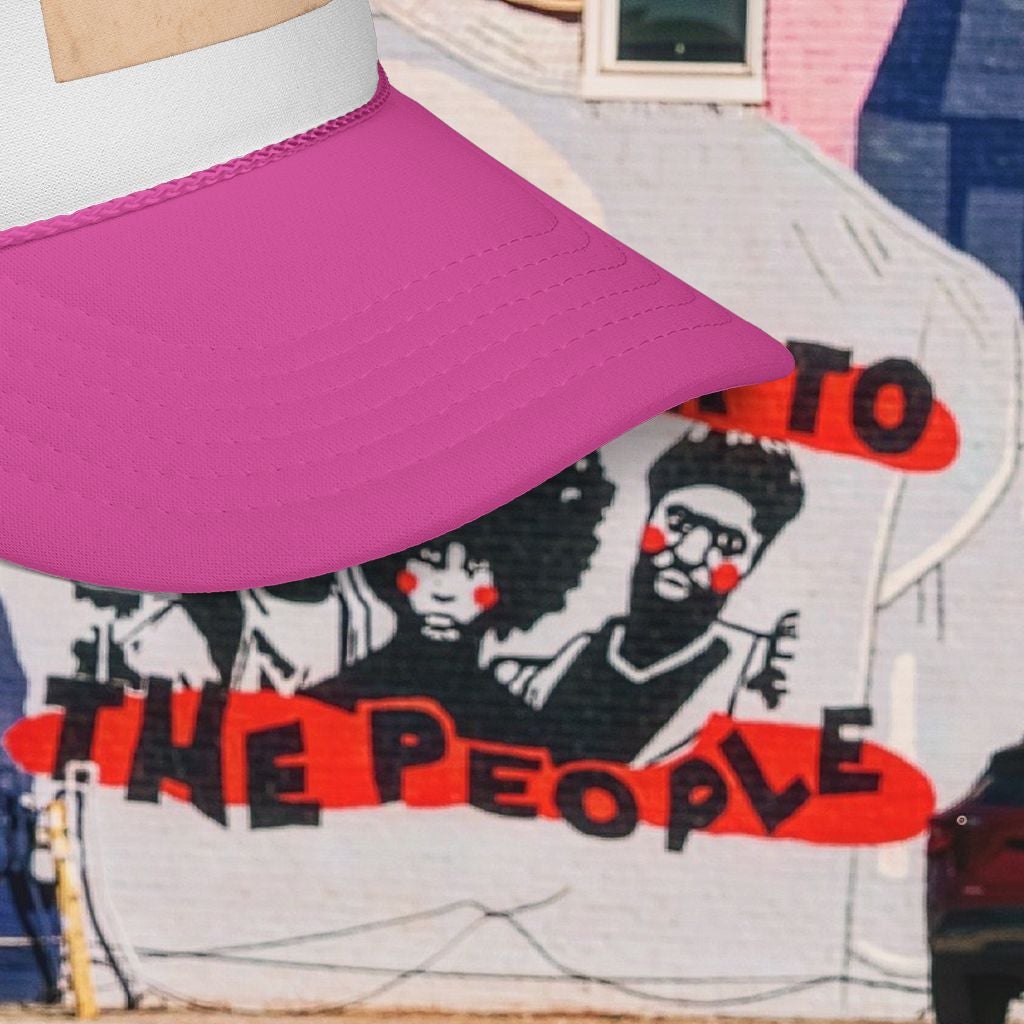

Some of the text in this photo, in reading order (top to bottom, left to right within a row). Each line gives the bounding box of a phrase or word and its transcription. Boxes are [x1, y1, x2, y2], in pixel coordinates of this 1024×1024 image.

[786, 340, 933, 454] TO
[45, 676, 881, 852] THE PEOPLE
